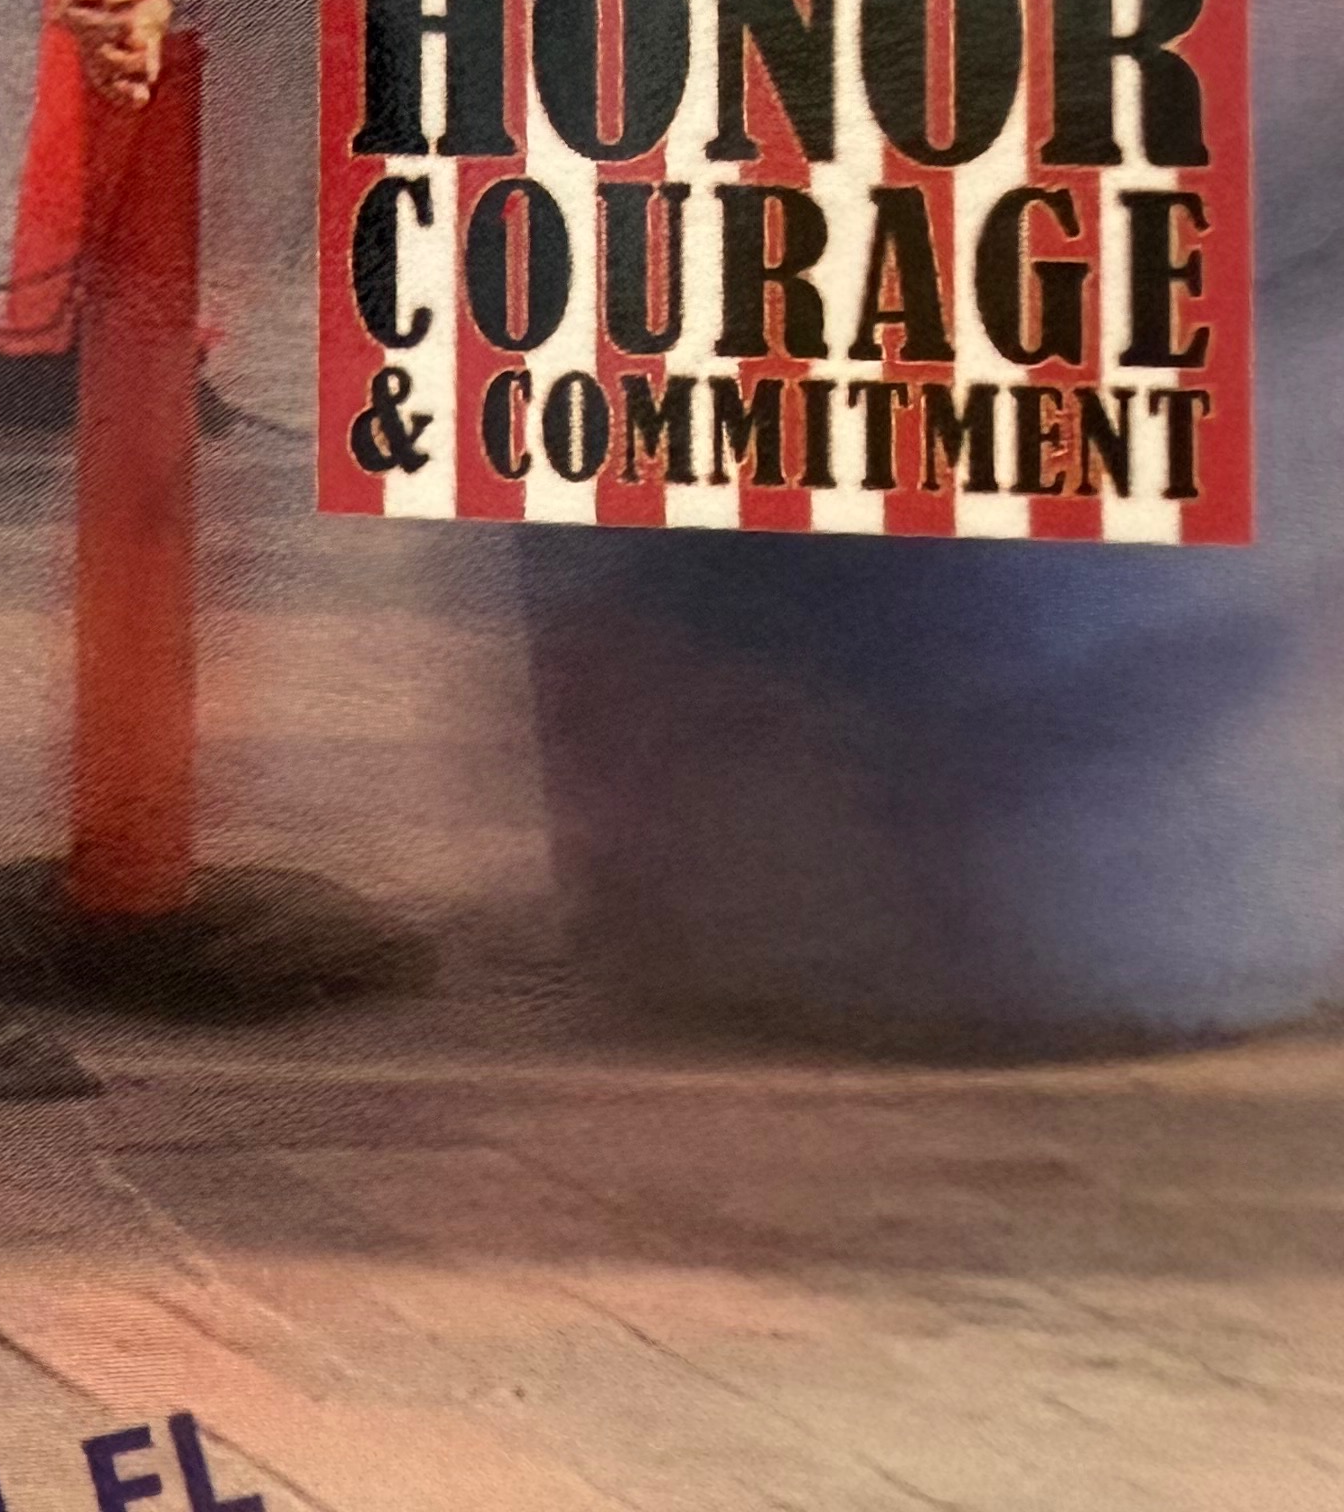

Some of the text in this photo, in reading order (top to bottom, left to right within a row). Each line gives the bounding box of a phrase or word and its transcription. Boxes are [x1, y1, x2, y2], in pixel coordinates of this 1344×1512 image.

[352, 175, 1211, 368] COURAGE
[349, 365, 1212, 501] & COMMITMENT
